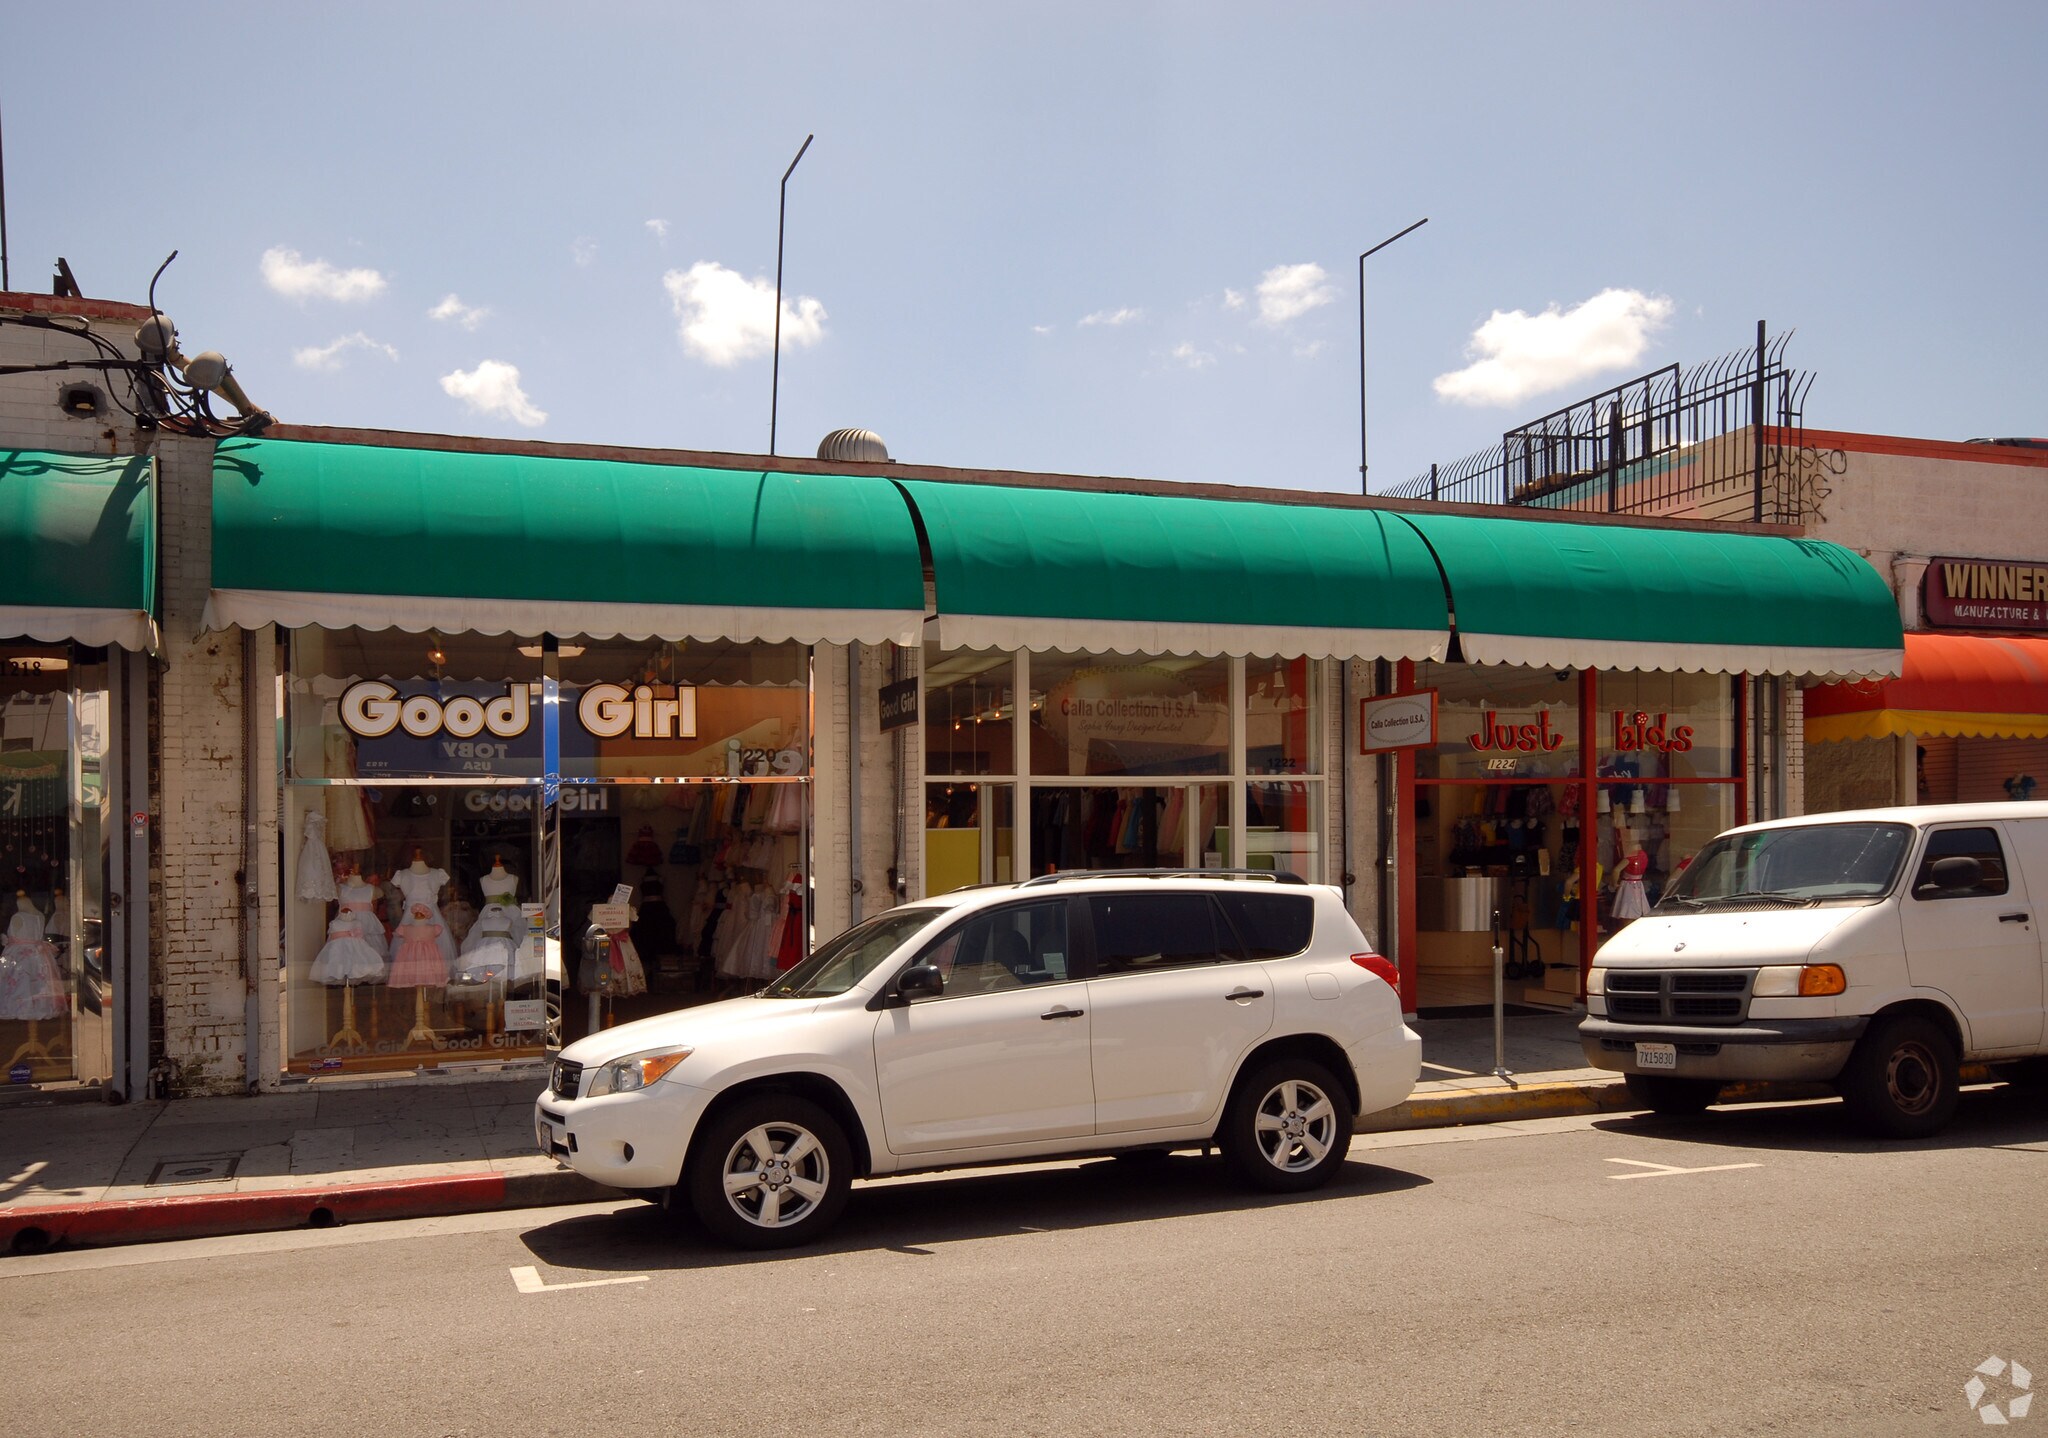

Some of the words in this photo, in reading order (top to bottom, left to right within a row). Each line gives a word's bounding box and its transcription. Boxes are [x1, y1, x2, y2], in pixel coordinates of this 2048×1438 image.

[1954, 605, 2028, 620] MANUFACTURE
[2033, 608, 2040, 620] &
[0, 661, 42, 676] 1218
[338, 680, 530, 739] Good
[577, 683, 698, 739] Girl
[881, 696, 899, 719] Good
[900, 690, 916, 713] Girl
[1061, 699, 1092, 717] Calla
[1096, 699, 1158, 718] Collection
[1162, 701, 1200, 718] U.S.A.
[1371, 720, 1383, 729] Calla
[1384, 717, 1408, 728] Collection
[1410, 714, 1425, 724] U.S.A.
[1468, 709, 1564, 752] Just
[736, 748, 776, 762] 1220
[1267, 758, 1296, 768] 1222
[1490, 759, 1516, 769] 1224
[559, 787, 608, 811] Girl
[315, 1040, 369, 1057] Good
[432, 1034, 483, 1050] Good
[489, 1032, 521, 1048] Girl
